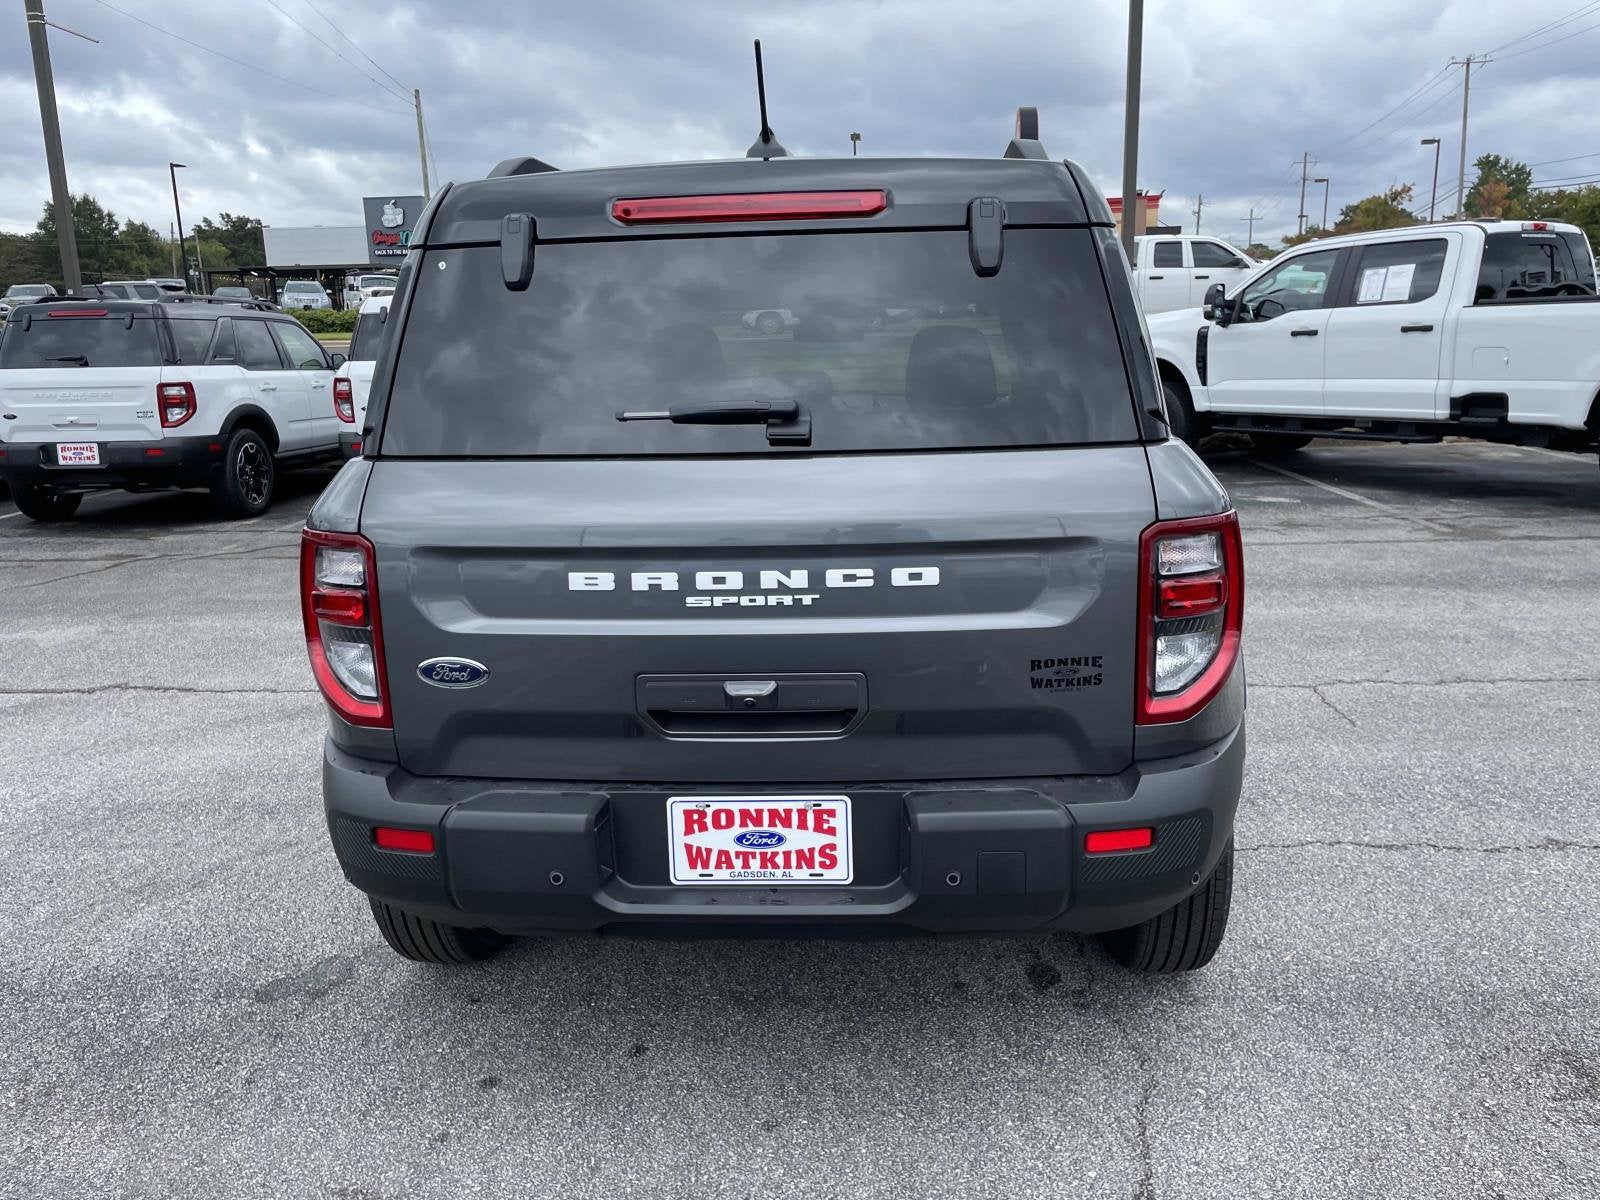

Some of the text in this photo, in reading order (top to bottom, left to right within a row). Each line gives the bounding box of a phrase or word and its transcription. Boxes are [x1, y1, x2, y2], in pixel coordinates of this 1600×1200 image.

[60, 446, 95, 454] RONNIE
[61, 454, 96, 462] WATKINS
[568, 566, 940, 591] BRONCO
[685, 594, 820, 607] SPORT
[432, 663, 471, 680] Ford
[1030, 656, 1103, 672] RONNIE
[1030, 673, 1103, 689] WATKINS
[683, 808, 837, 837] RONNIE
[742, 832, 779, 845] Ford
[684, 843, 838, 870] WATKINS
[729, 871, 778, 879] GADSDEN,
